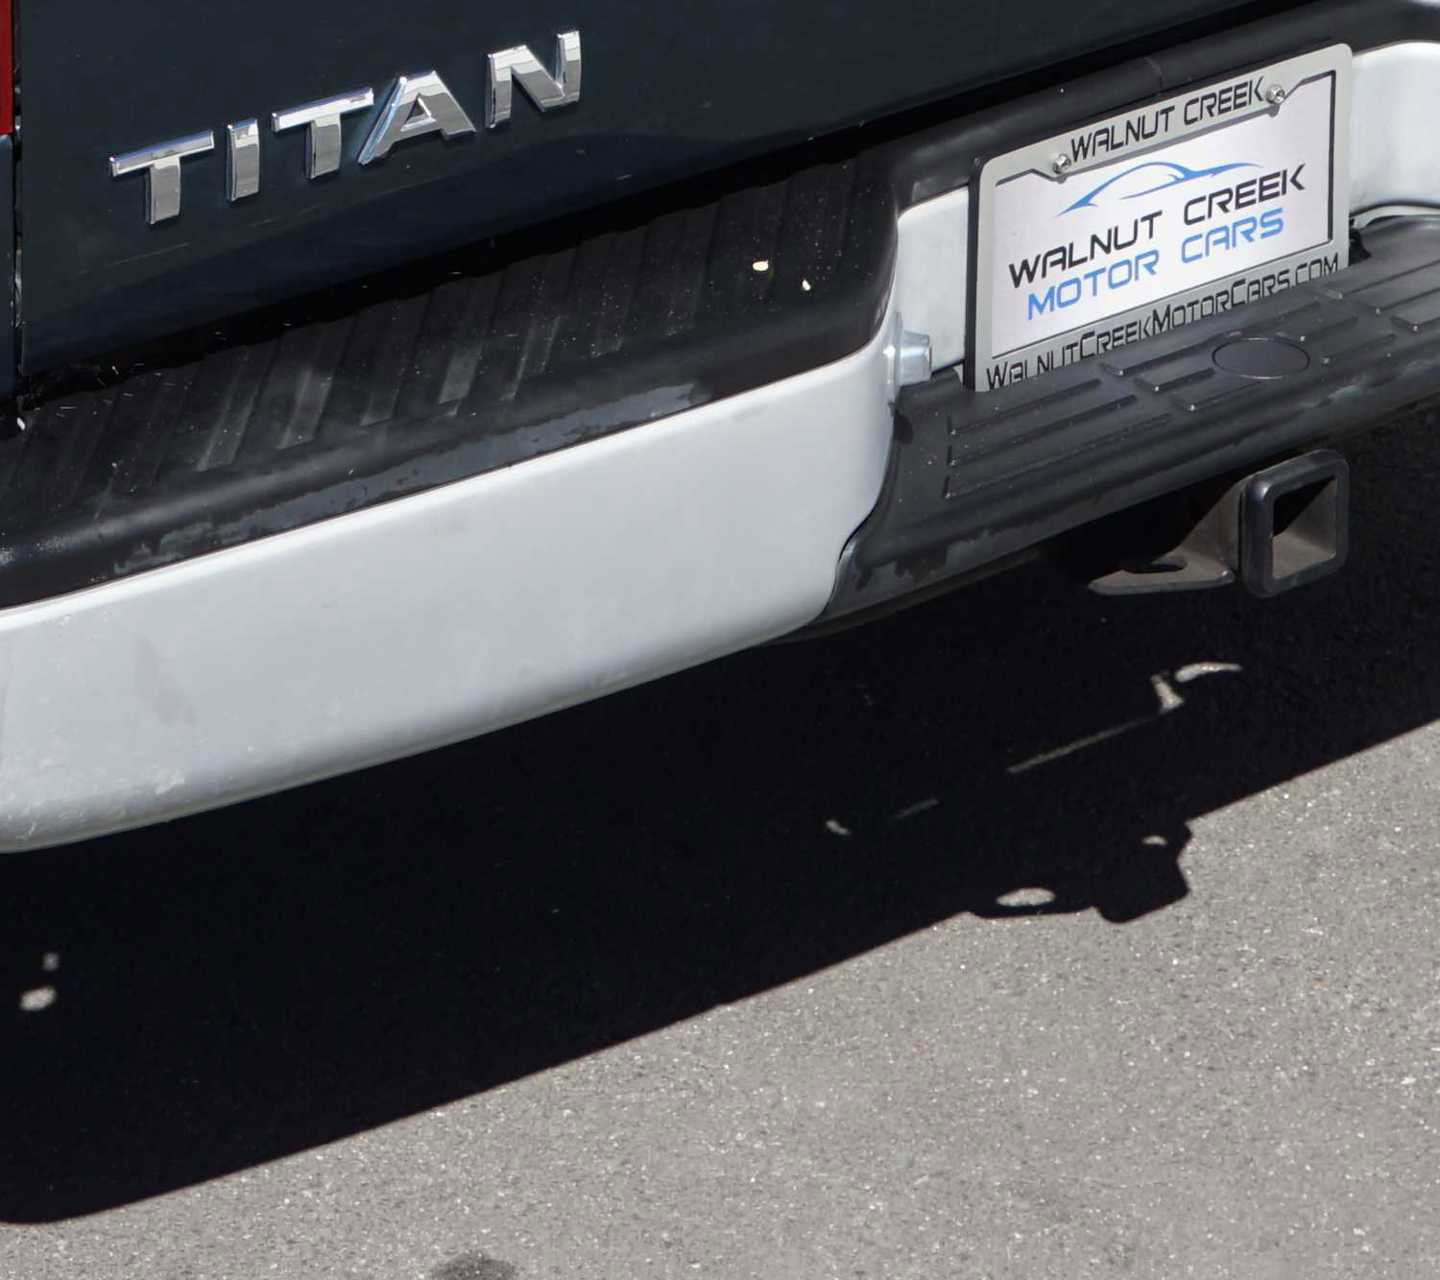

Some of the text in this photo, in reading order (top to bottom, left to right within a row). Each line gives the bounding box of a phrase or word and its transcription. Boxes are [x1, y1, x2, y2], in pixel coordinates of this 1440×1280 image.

[108, 30, 583, 226] TITAN
[1069, 76, 1264, 163] WALNUT CREEK
[1008, 163, 1307, 289] WALNUT CREEK
[1027, 206, 1286, 321] MOTOR CARS
